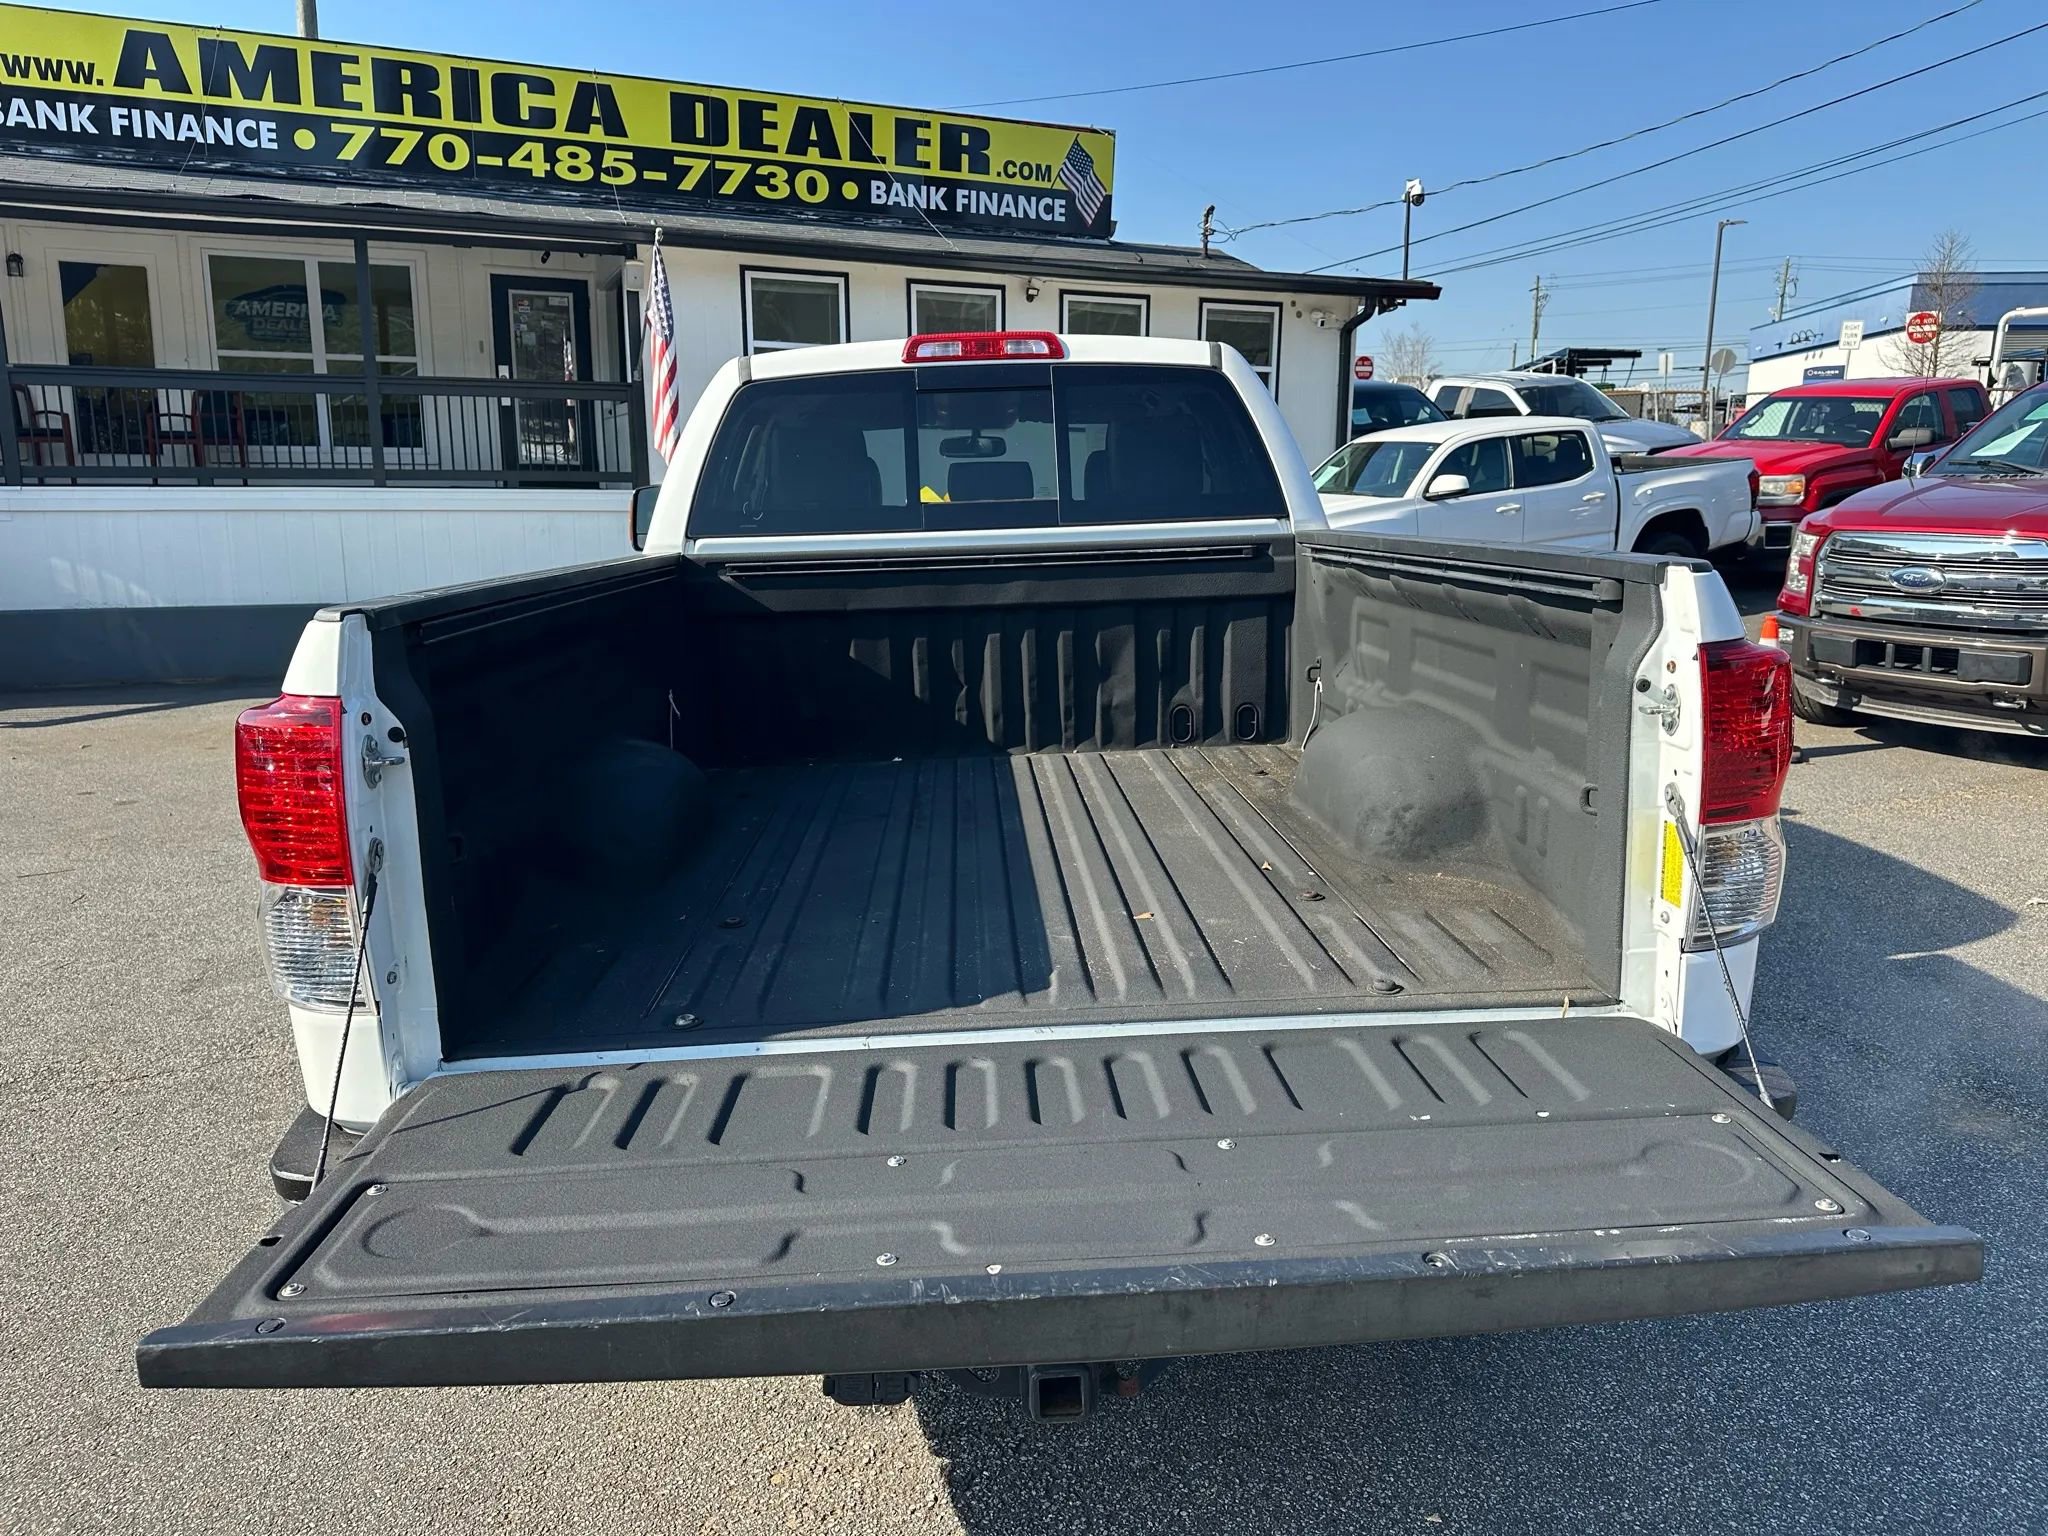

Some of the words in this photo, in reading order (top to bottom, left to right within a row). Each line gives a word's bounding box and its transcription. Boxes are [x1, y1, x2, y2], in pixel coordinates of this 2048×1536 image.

[113, 29, 628, 139] AMERICA
[110, 106, 278, 150] FINANCE
[330, 123, 830, 203] 770-485-7730
[870, 180, 948, 211] BANK
[956, 188, 1066, 222] FINANCE
[233, 300, 338, 321] AMERIA
[253, 319, 310, 331] DEALE
